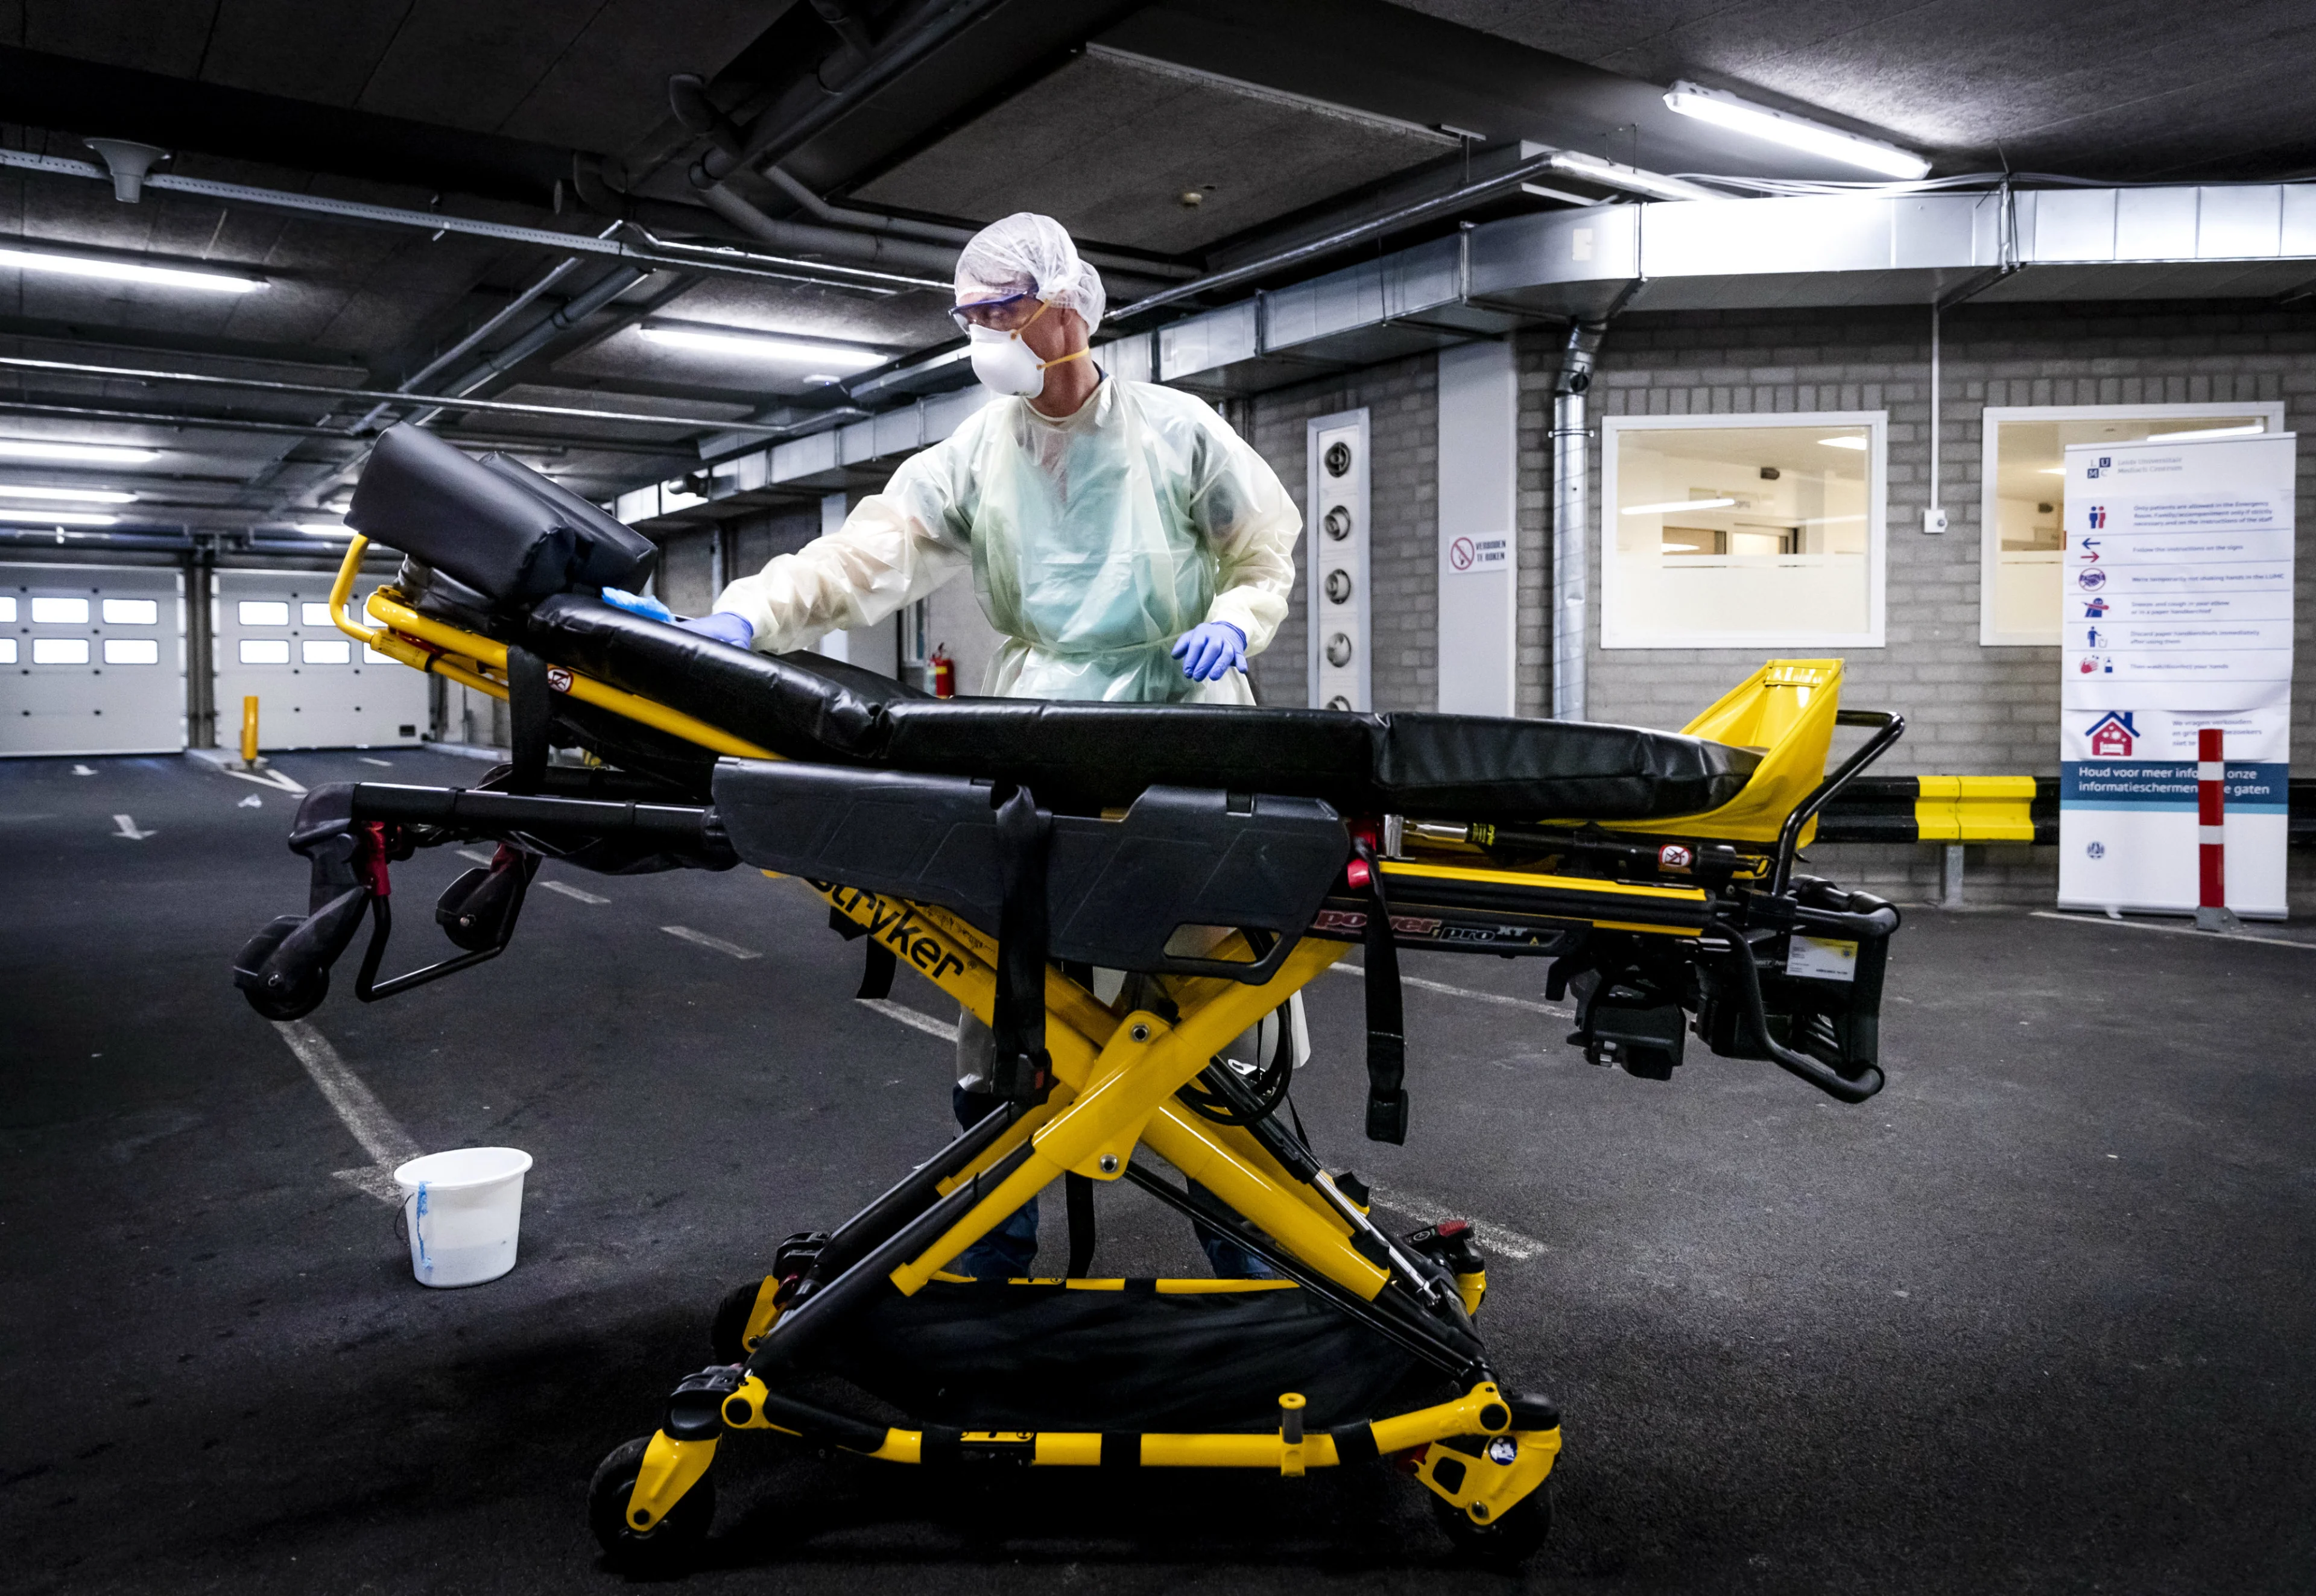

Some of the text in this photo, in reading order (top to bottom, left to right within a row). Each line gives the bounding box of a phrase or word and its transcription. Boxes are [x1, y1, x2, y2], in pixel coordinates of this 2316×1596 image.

[2078, 767, 2110, 778] Houd
[2113, 769, 2139, 778] voor
[2142, 769, 2173, 778] meer
[2227, 770, 2257, 779] onze
[2078, 781, 2198, 793] informatieschermen
[2234, 784, 2270, 796] gaten
